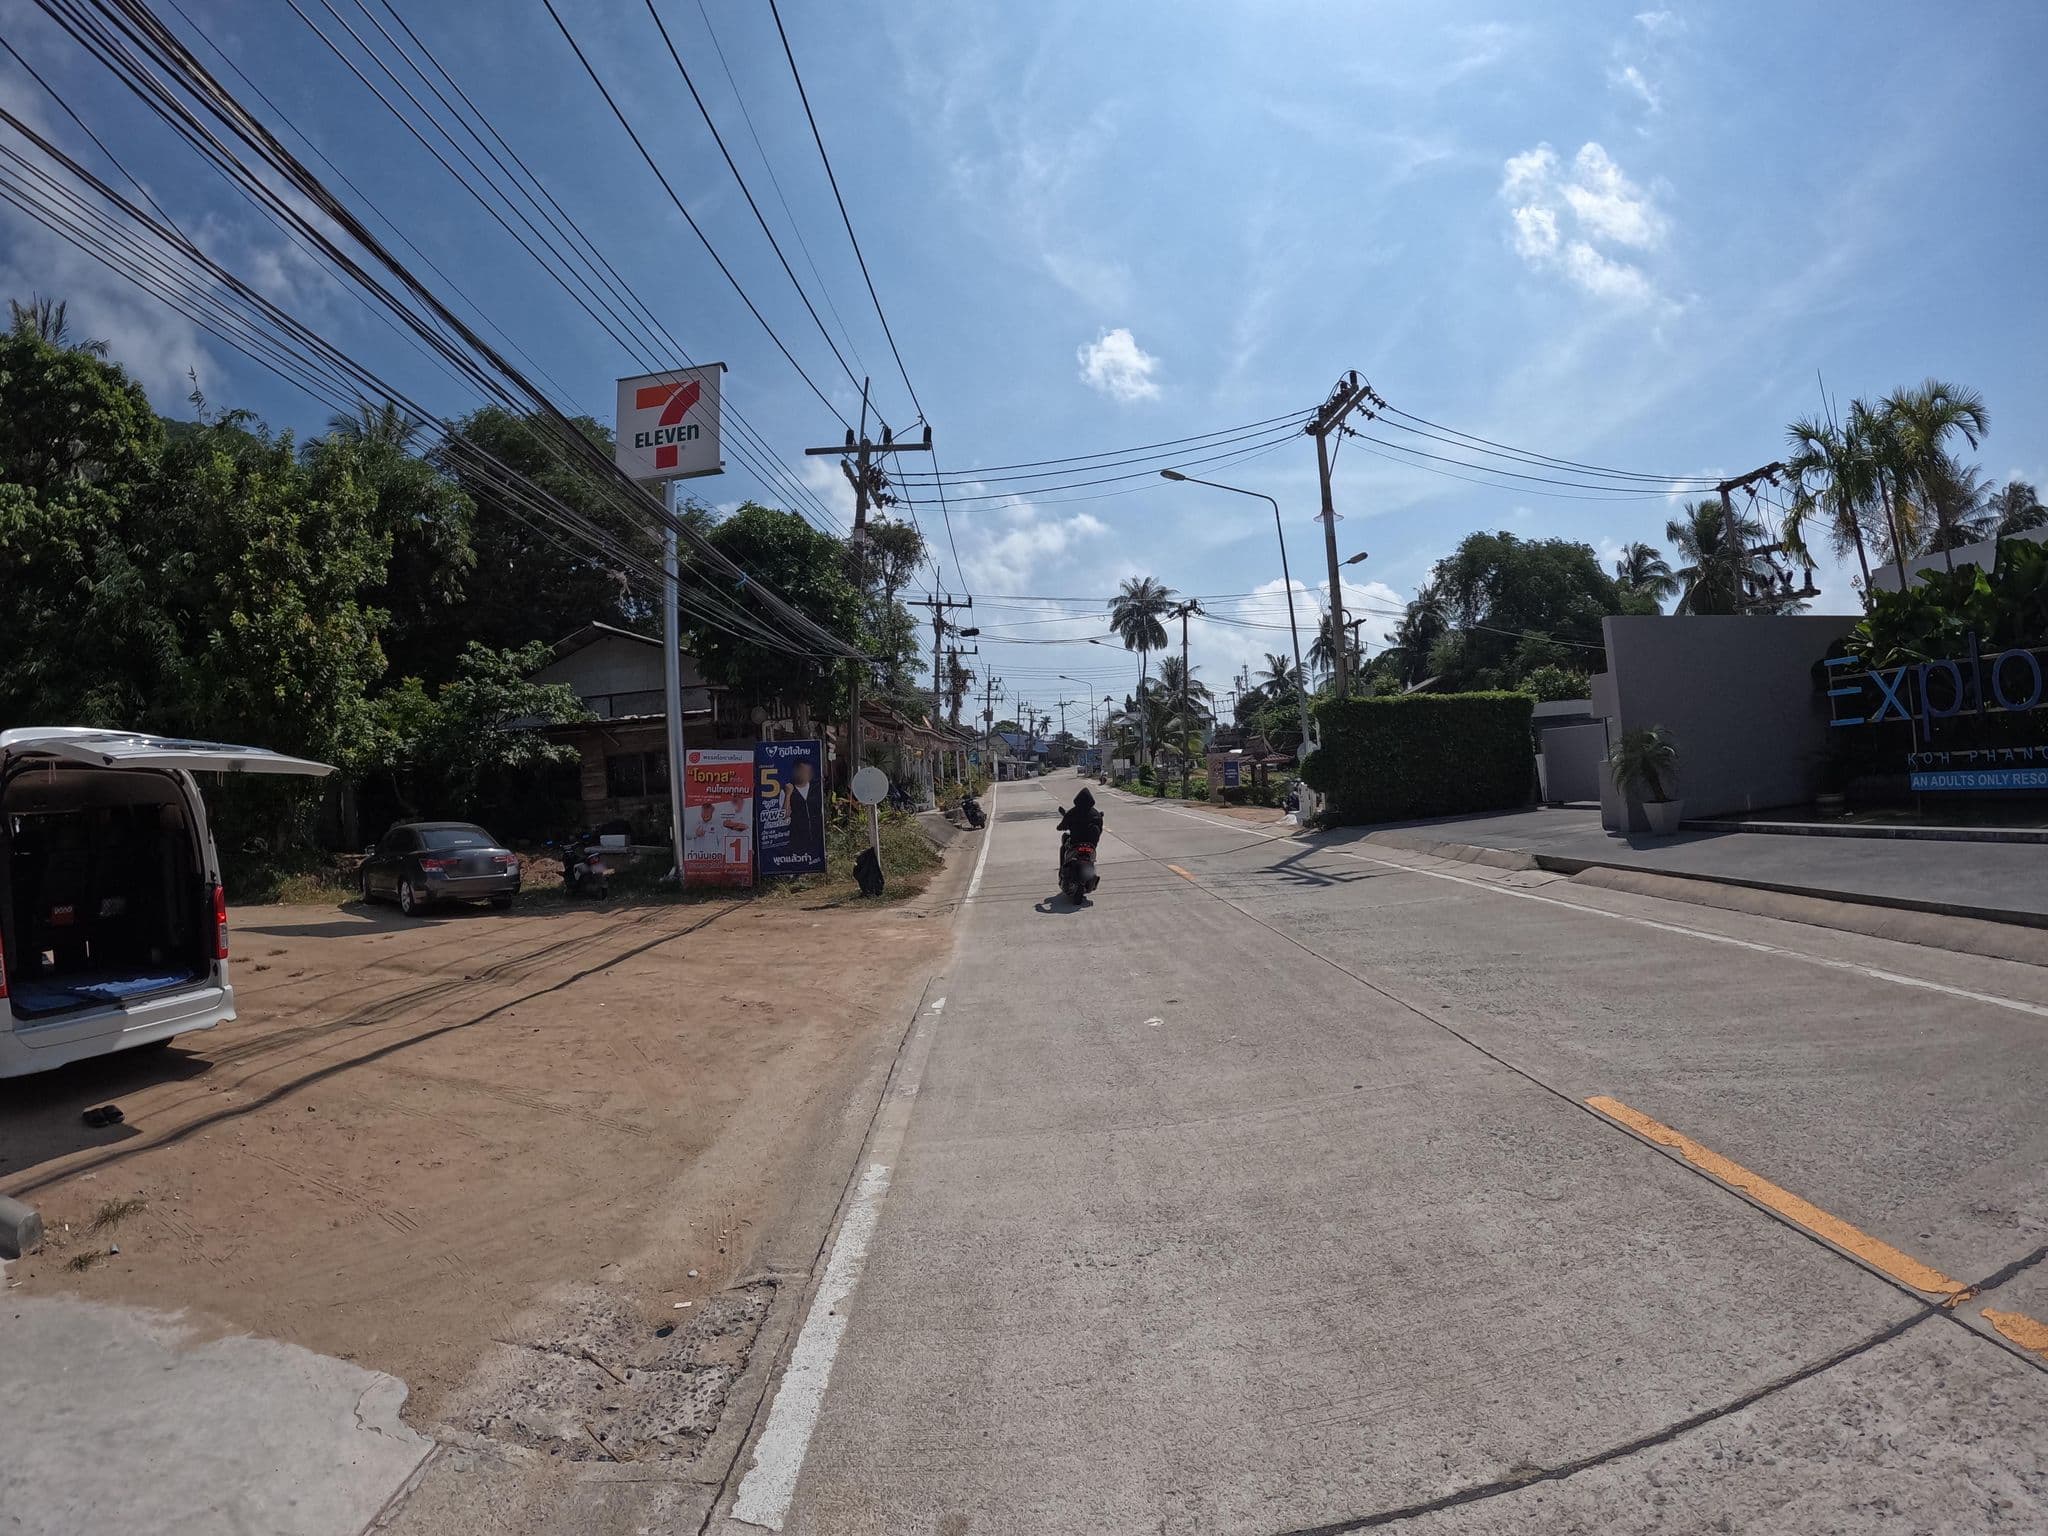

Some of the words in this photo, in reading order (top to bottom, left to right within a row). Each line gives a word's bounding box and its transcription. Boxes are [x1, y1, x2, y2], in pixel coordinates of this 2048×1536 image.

[1824, 631, 2043, 742] Explo
[777, 746, 811, 758] ภูมิใจไทย
[1907, 752, 1950, 765] KOH
[760, 768, 781, 798] 5
[1912, 776, 1928, 786] AN
[1930, 775, 1974, 786] ADULTS
[1978, 774, 2008, 785] ONLY
[2012, 772, 2047, 784] RESO
[729, 838, 741, 861] 1
